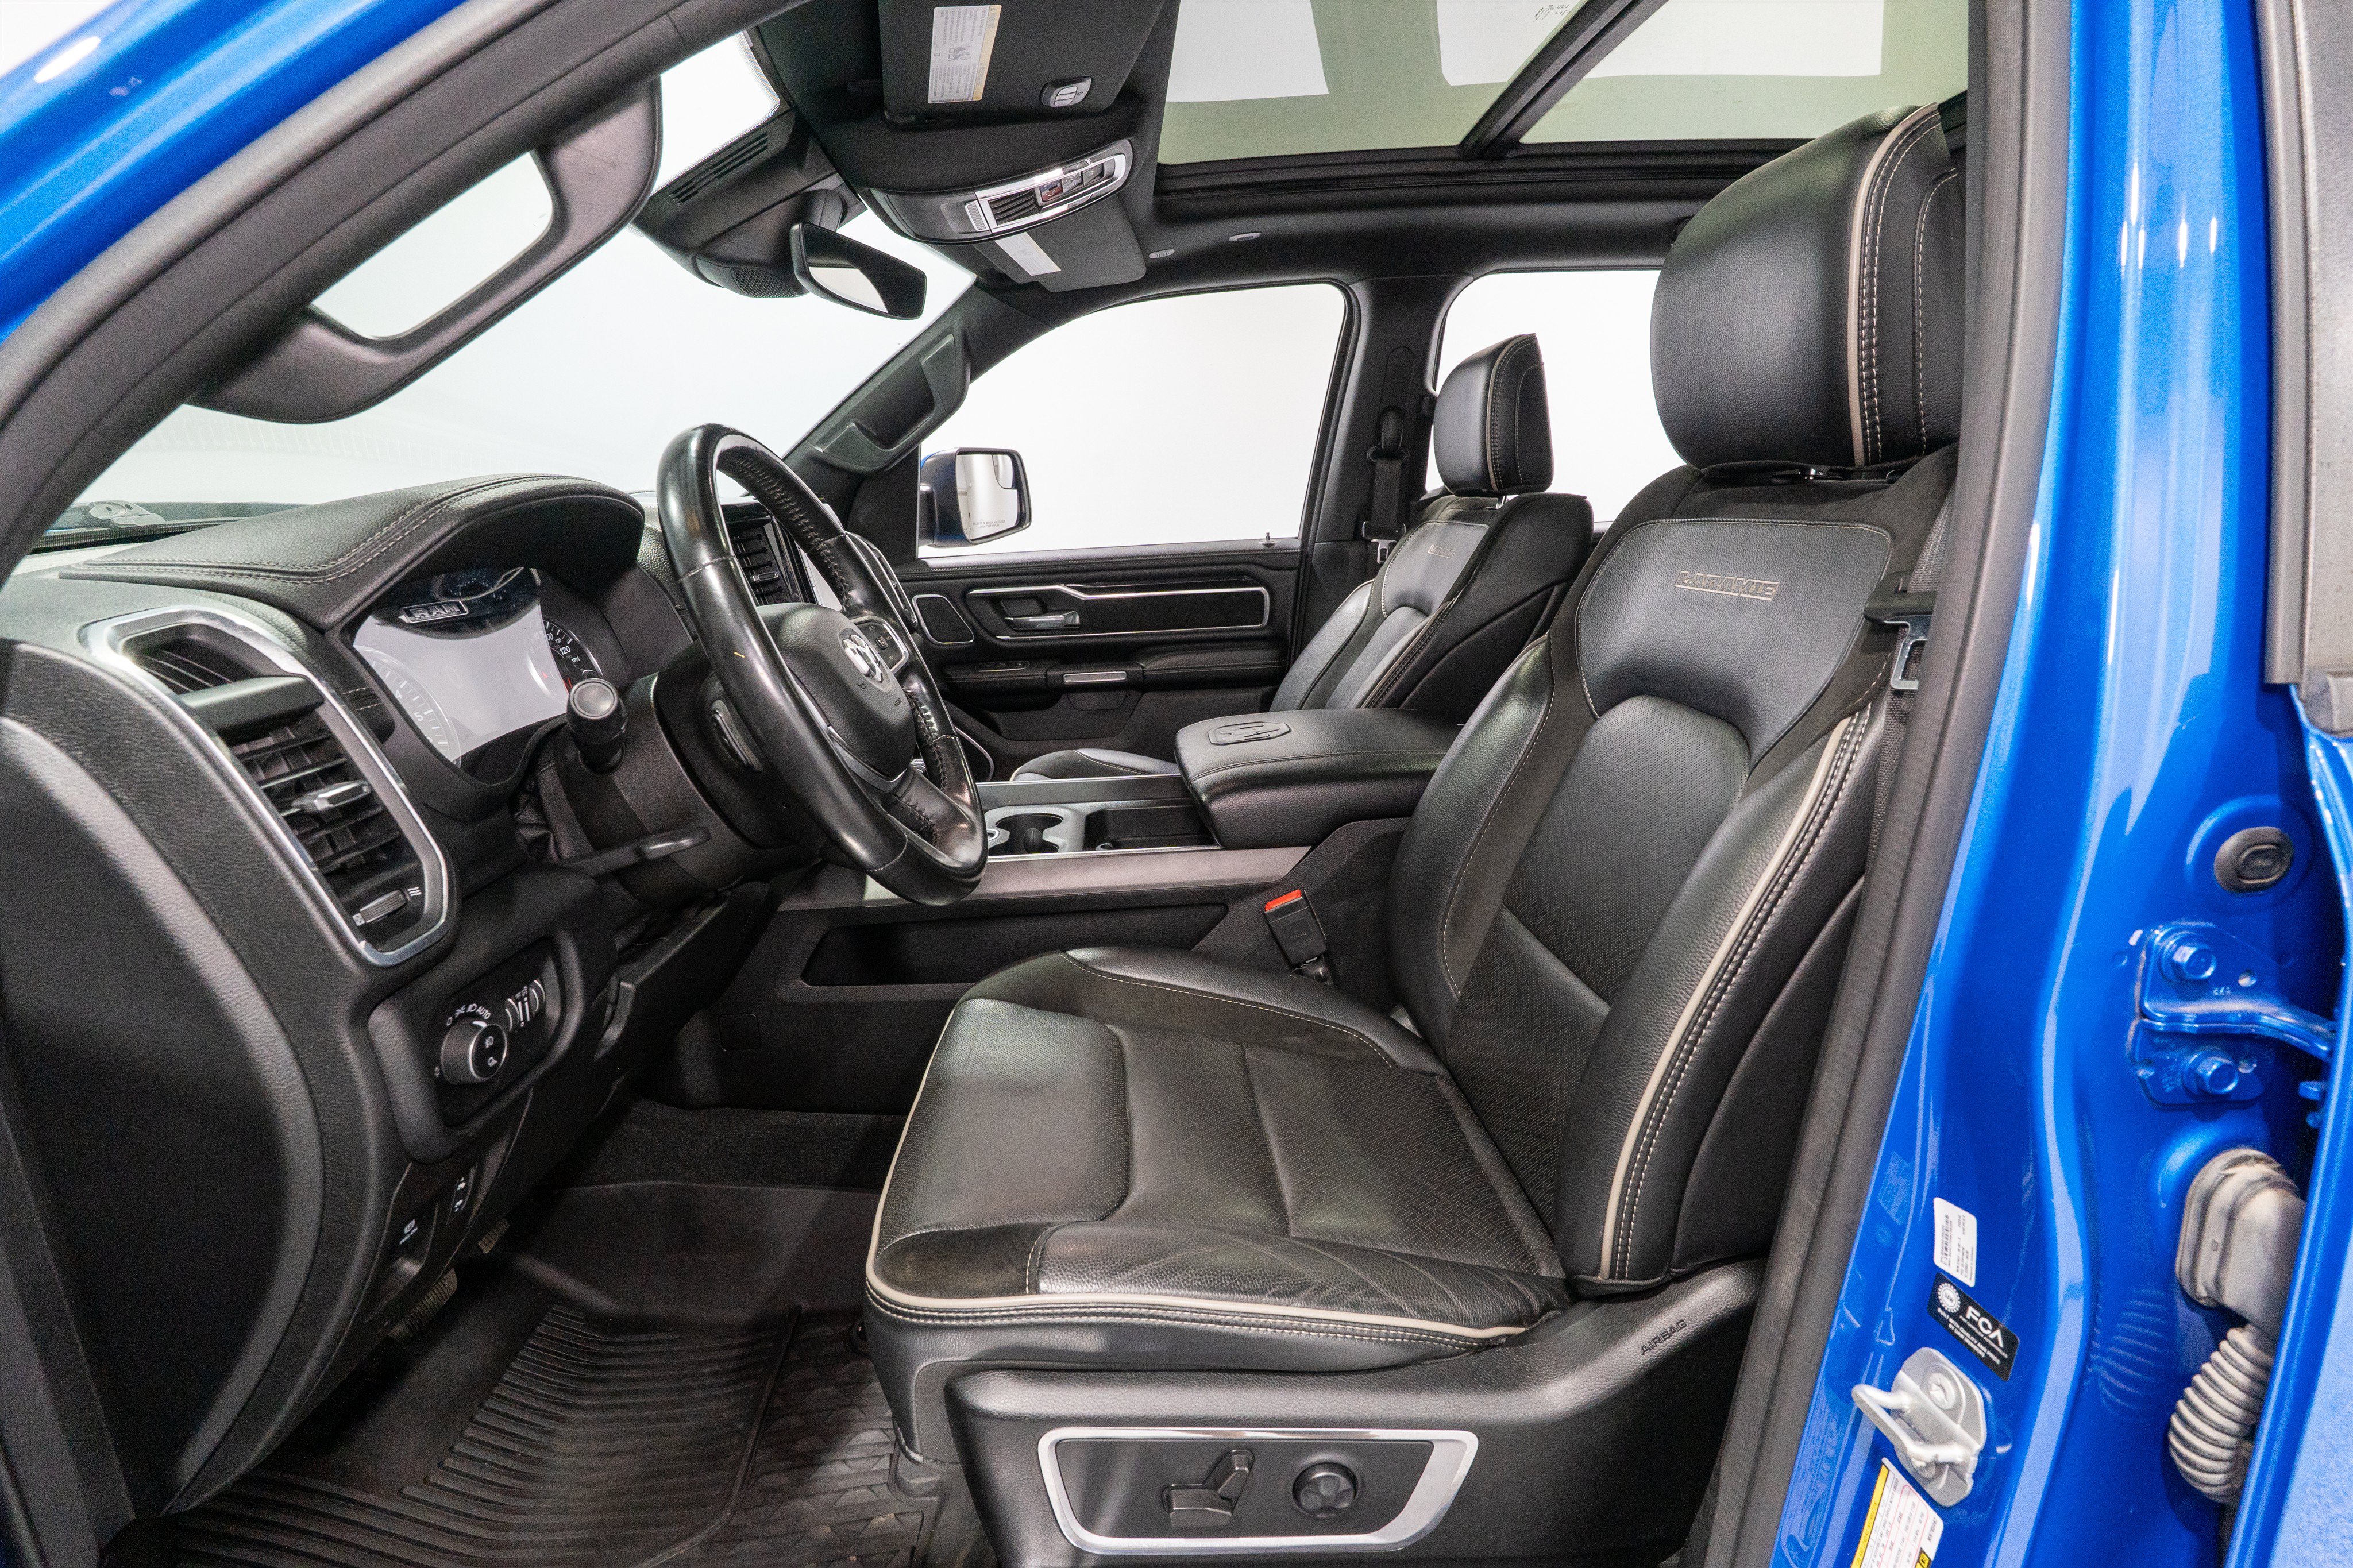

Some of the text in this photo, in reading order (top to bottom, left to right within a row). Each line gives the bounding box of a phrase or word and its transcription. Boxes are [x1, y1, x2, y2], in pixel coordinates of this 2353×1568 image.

[1675, 570, 1780, 601] LARAMIE
[409, 603, 461, 620] RAM
[560, 646, 571, 655] 120
[395, 689, 403, 700] 4
[414, 712, 424, 721] 5
[476, 1006, 491, 1019] AUTO
[1965, 1305, 2004, 1349] FCA
[1640, 1319, 1687, 1355] AIRBAG
